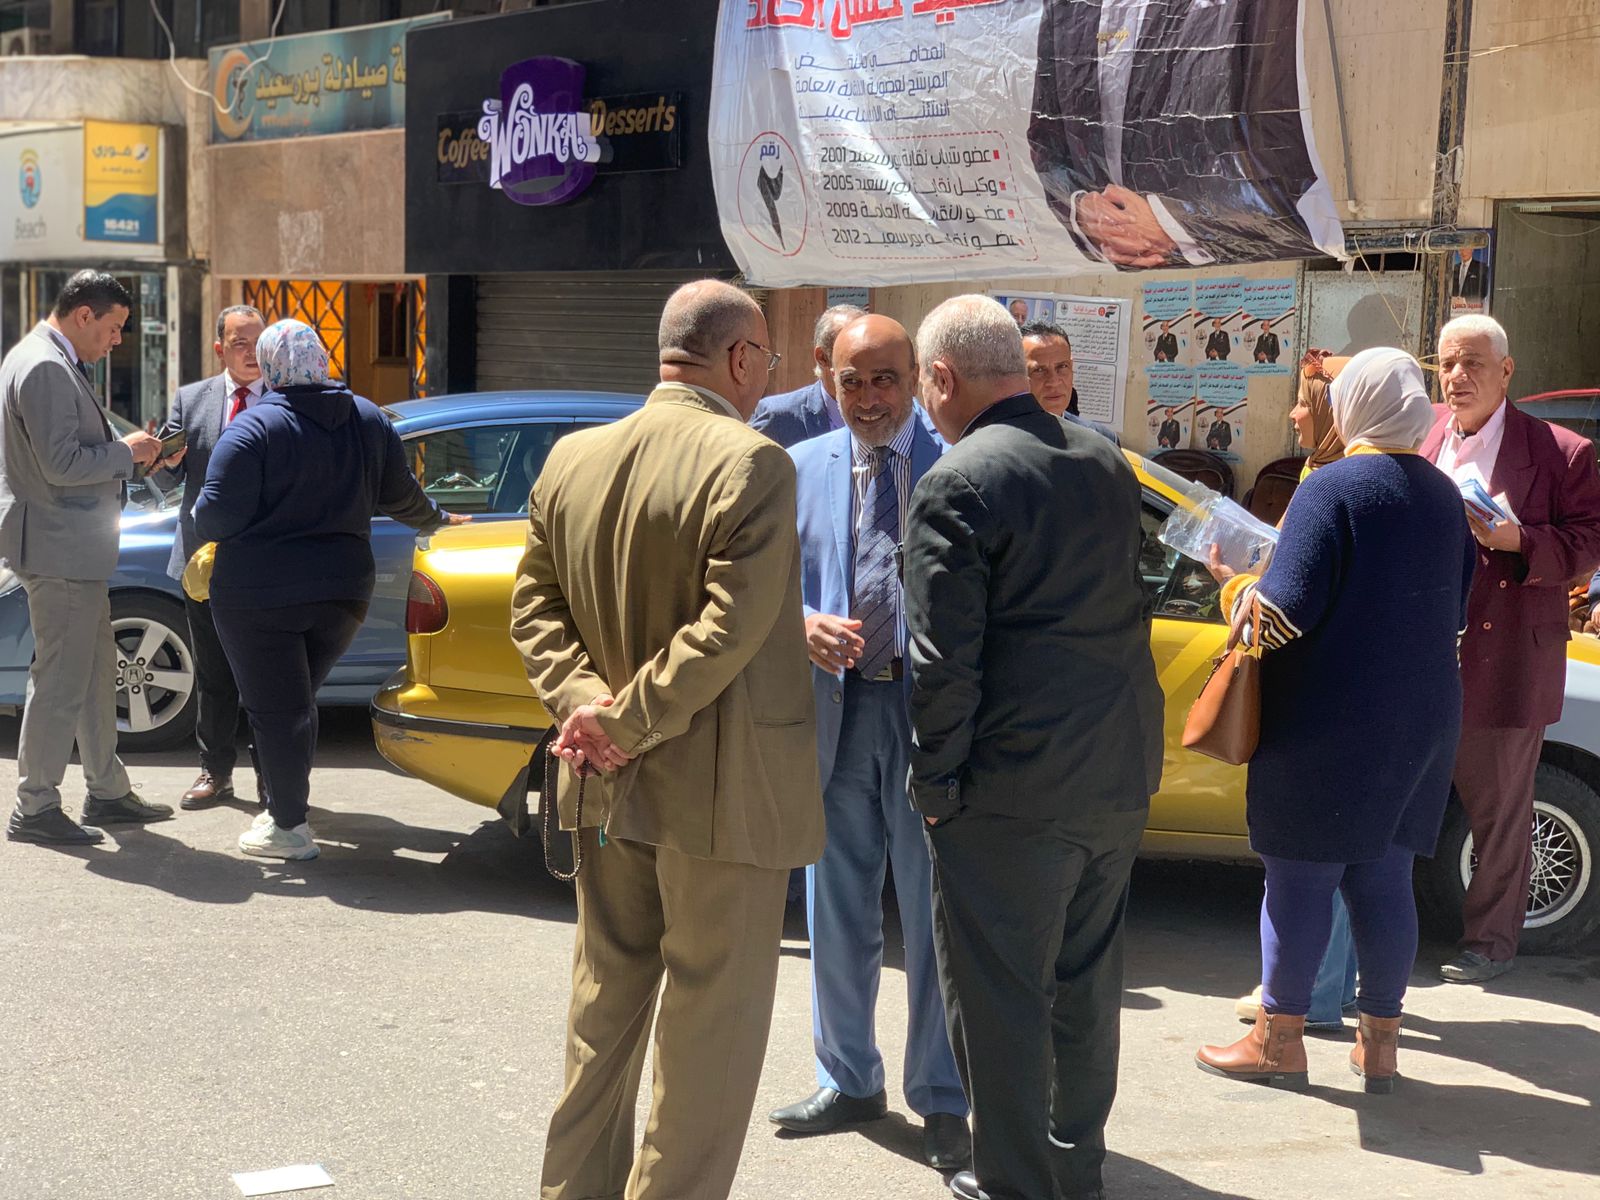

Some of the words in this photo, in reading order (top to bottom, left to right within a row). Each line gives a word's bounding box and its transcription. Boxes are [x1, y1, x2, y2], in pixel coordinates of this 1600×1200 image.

[870, 42, 946, 72] المحامي
[322, 53, 388, 99] صيادلة
[795, 76, 835, 94] العامة
[908, 71, 948, 96] المرشح
[437, 127, 489, 168] Coffee
[590, 96, 677, 137] Desserts
[760, 141, 780, 161] رقم
[821, 146, 847, 163] 2001
[902, 148, 928, 171] نقابة
[931, 146, 961, 169] شباب
[963, 146, 992, 168] عضو
[823, 175, 853, 190] 2005
[954, 176, 998, 196] وكيل
[826, 202, 858, 218] 2009
[861, 201, 901, 219] العامة
[966, 204, 1006, 223] عضو
[832, 229, 861, 244] 2012
